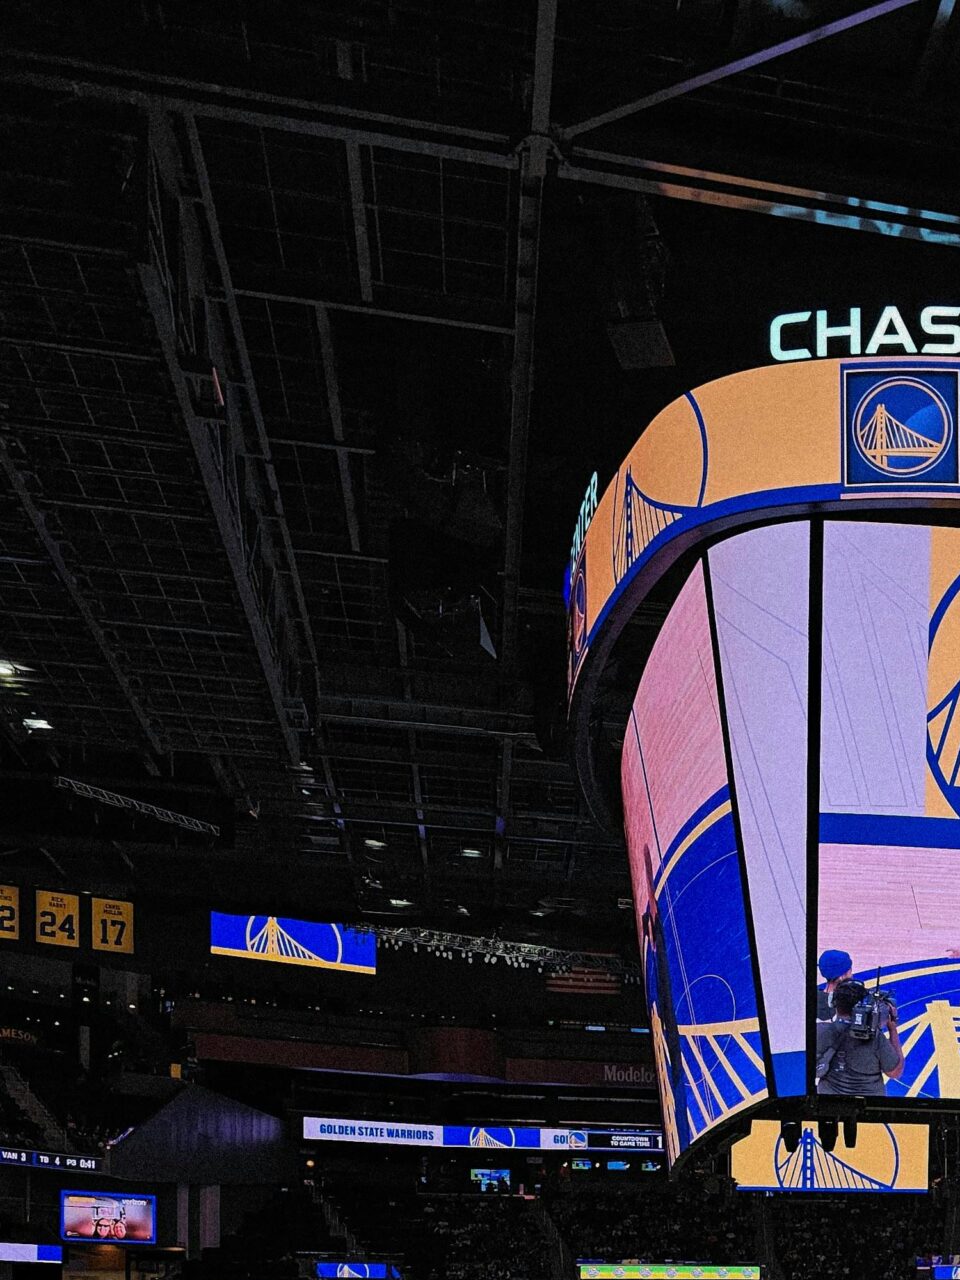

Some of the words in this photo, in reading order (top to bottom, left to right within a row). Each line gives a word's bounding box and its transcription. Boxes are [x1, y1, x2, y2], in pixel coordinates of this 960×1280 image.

[39, 910, 75, 940] 24
[100, 918, 126, 945] 17
[604, 1064, 654, 1083] Modelo
[319, 1123, 356, 1136] GOLDEN
[357, 1126, 385, 1138] STATE
[386, 1128, 434, 1141] WARRIORS
[1, 1151, 18, 1160] VAN
[20, 1152, 27, 1162] 3
[54, 1157, 60, 1166] 4
